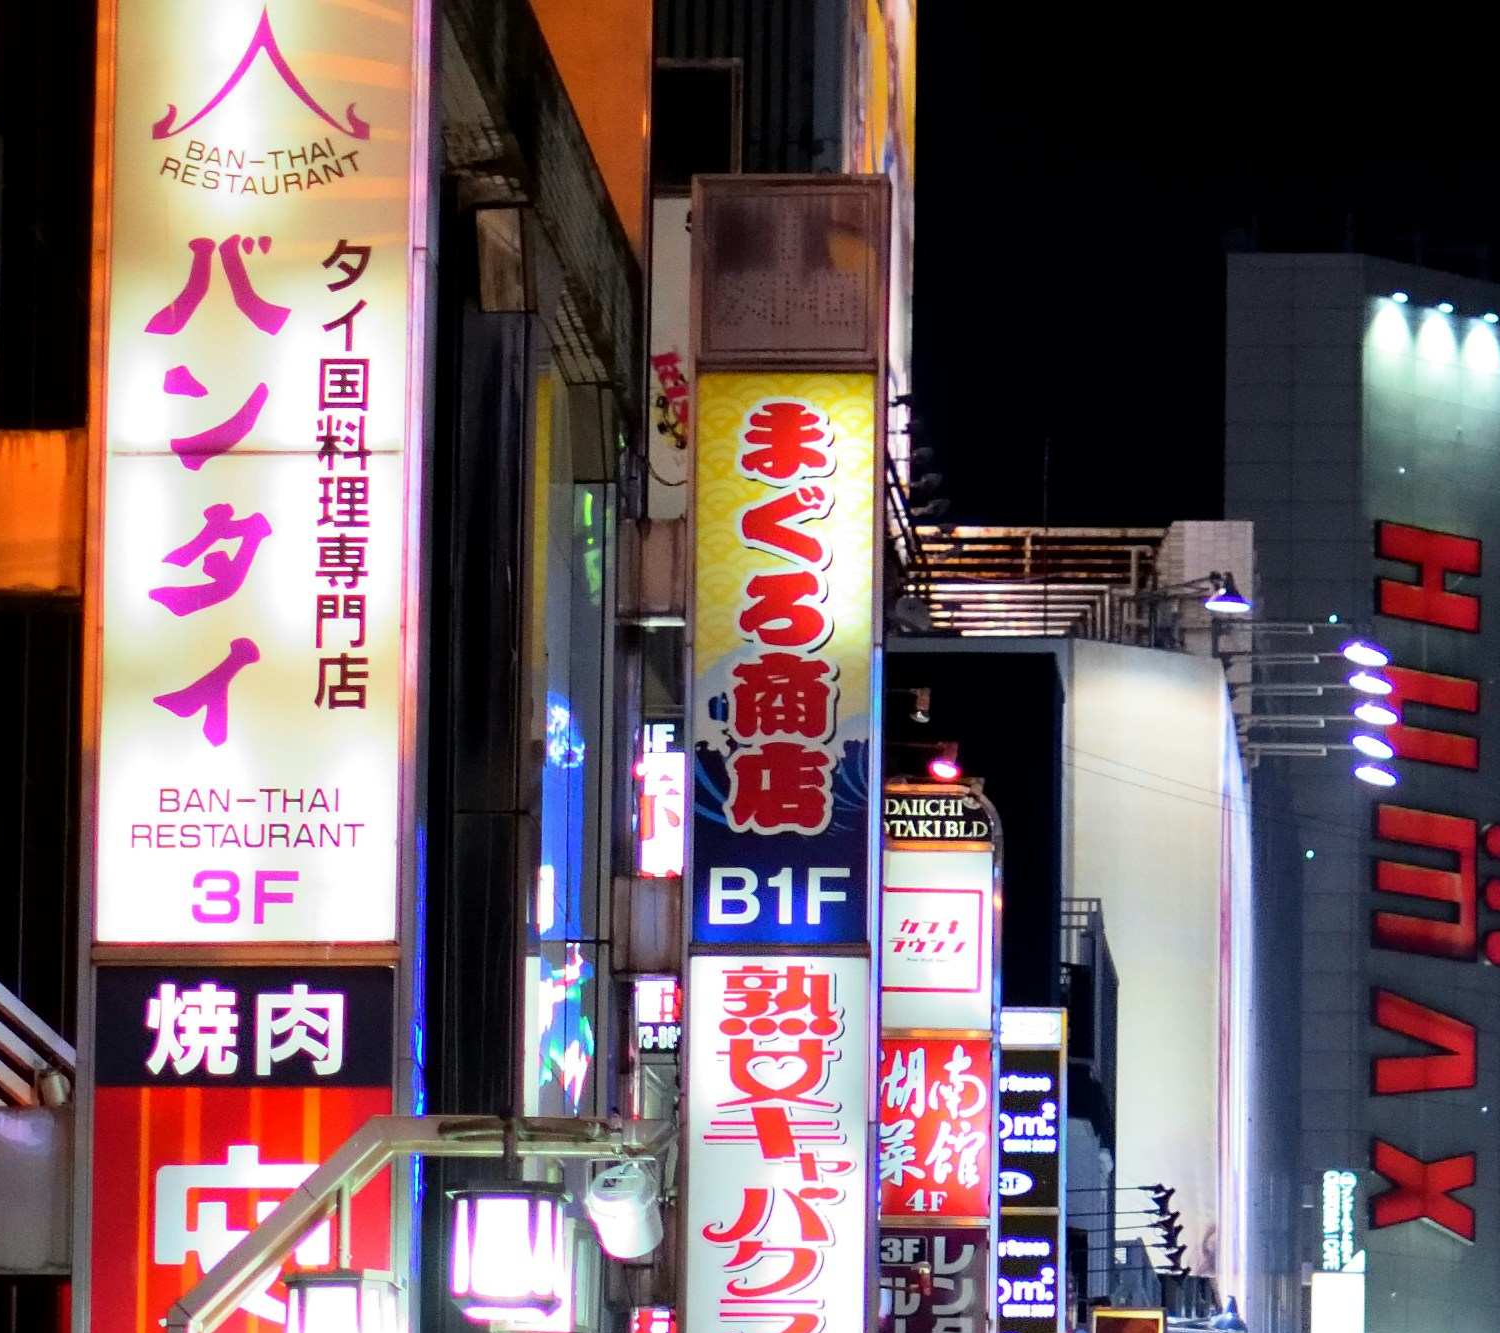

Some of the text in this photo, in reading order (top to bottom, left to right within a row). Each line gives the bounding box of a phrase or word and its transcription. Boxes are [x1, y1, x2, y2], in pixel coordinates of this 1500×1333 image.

[158, 150, 362, 195] RESTAURANT
[184, 137, 336, 172] BAN-THAI
[145, 233, 292, 747] バンタイ
[312, 239, 372, 711] タイ国料理専門店
[734, 399, 835, 832] まぐろ商店
[159, 787, 340, 814] BAN-THAI
[884, 798, 964, 817] DAIICHI
[131, 822, 364, 850] RESTAURANT
[192, 871, 299, 925] 3F
[707, 868, 850, 926] B1F
[146, 984, 346, 1076] 焼肉
[905, 1190, 948, 1212] 4F
[881, 1238, 920, 1262] 3F
